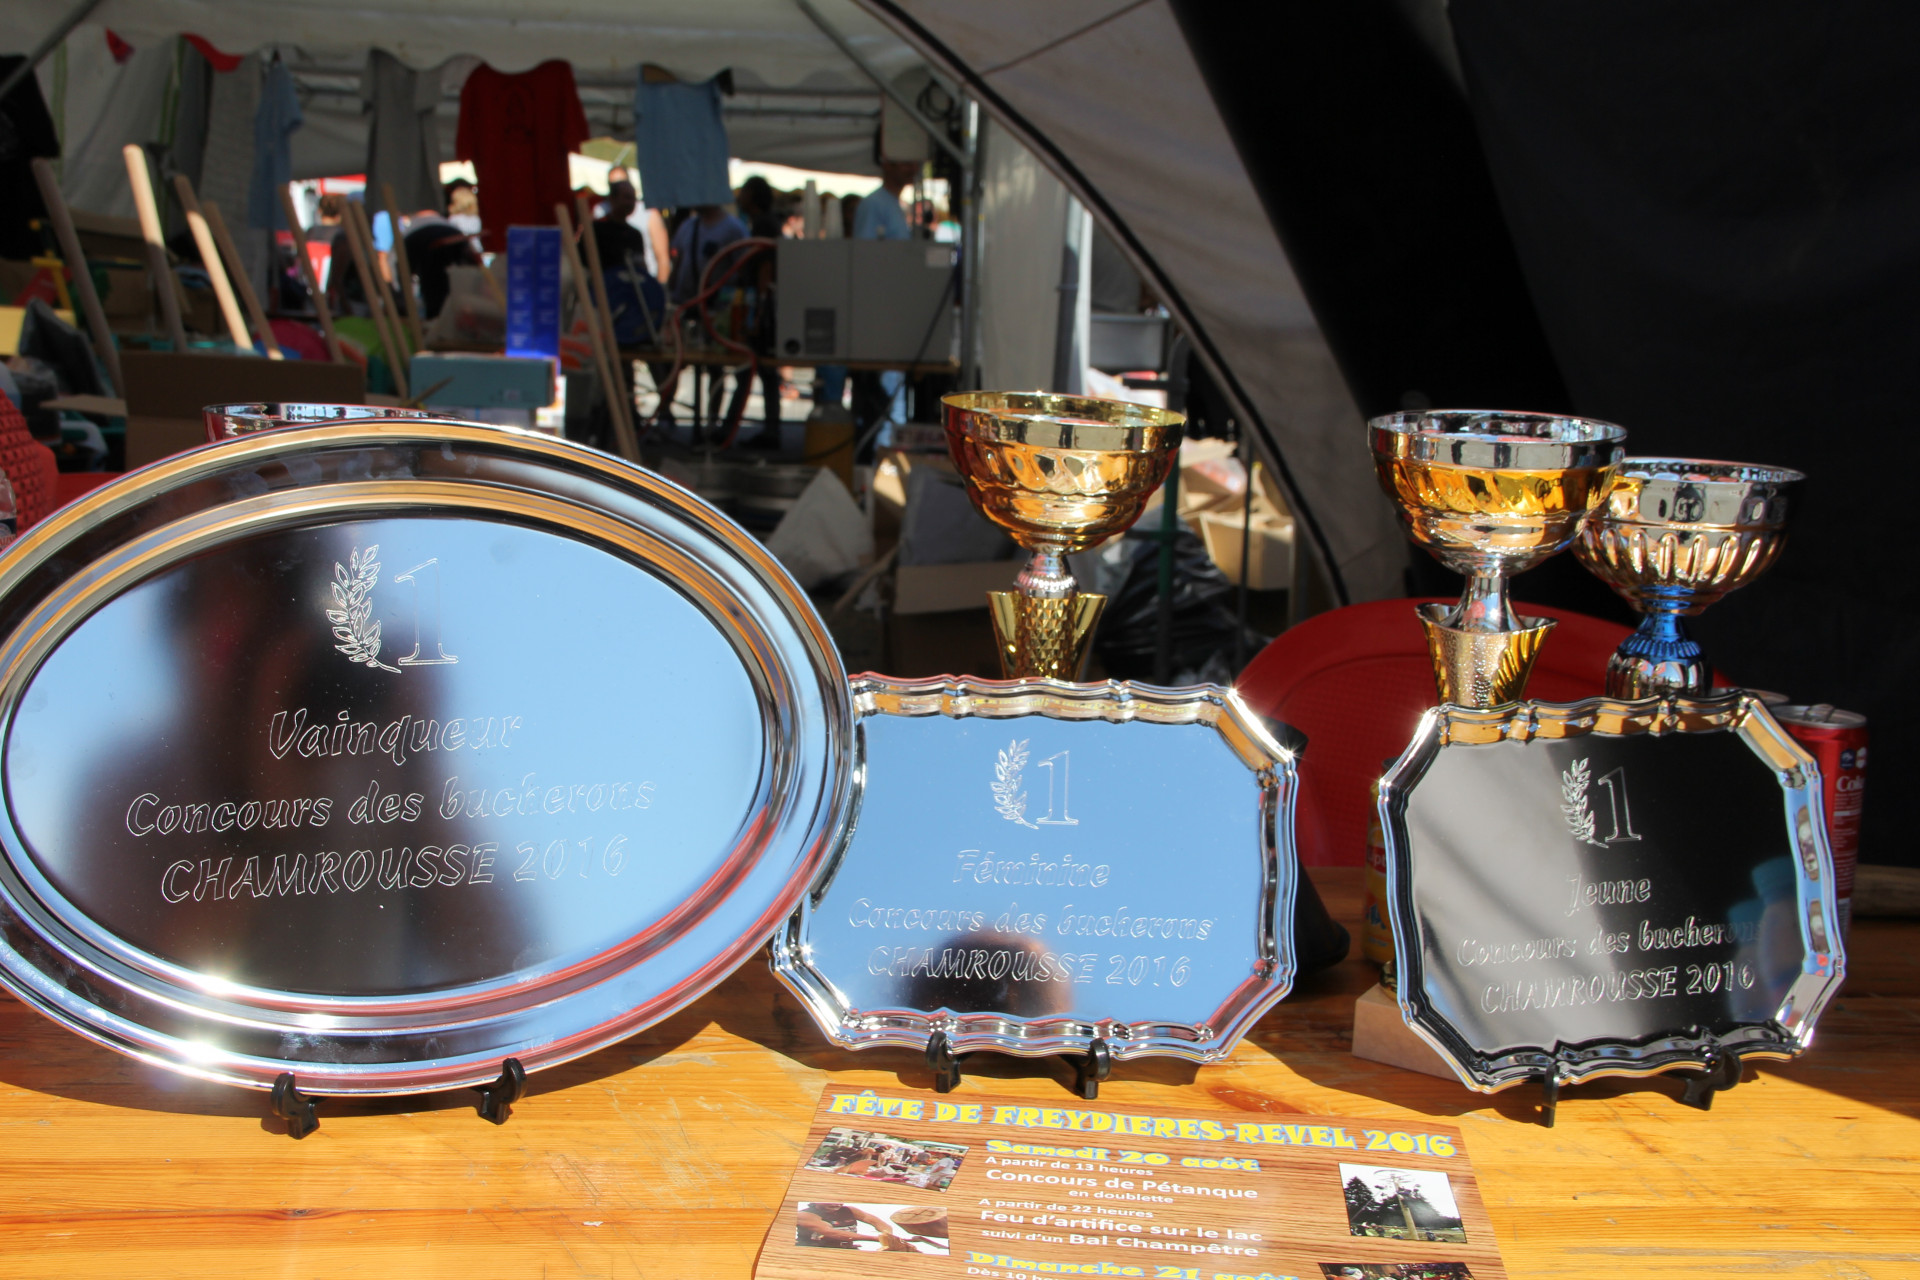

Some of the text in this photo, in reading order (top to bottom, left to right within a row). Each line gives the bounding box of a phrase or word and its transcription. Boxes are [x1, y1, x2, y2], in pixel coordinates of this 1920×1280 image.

[268, 708, 523, 765] Vainqueur
[126, 772, 657, 837] Concours des bucherons
[161, 833, 631, 904] CHAMROUSSE 2016
[953, 849, 1111, 888] Féminine
[1565, 873, 1652, 917] Jeune
[849, 897, 1213, 941] Concours des bucherons
[1456, 936, 1577, 967] Concours
[1584, 923, 1631, 955] des
[868, 945, 1192, 987] CHAMROUSSE 2016
[1481, 960, 1755, 1014] CHAMROUSSE 2016
[827, 1090, 1457, 1158] FÊTE DE FREYDIERES-REVEL 2016
[985, 1156, 1154, 1177] A partir de 13 heures
[986, 1140, 1262, 1172] Samedi 20 août
[985, 1169, 1260, 1200] Concours de Pétanque
[1068, 1189, 1174, 1204] en doublette
[978, 1198, 1155, 1218] A partir de 22 heures
[980, 1210, 1025, 1224] Feu
[1149, 1225, 1190, 1237] sur
[1196, 1226, 1220, 1239] le
[1226, 1228, 1264, 1242] lac
[981, 1228, 1022, 1240] suivi
[1069, 1233, 1109, 1246] Bal
[1115, 1237, 1260, 1257] Champêtre
[965, 1250, 1145, 1277] Dimanche
[1154, 1265, 1200, 1280] 21
[967, 1266, 1000, 1277] Dès
[1005, 1271, 1027, 1280] 10
